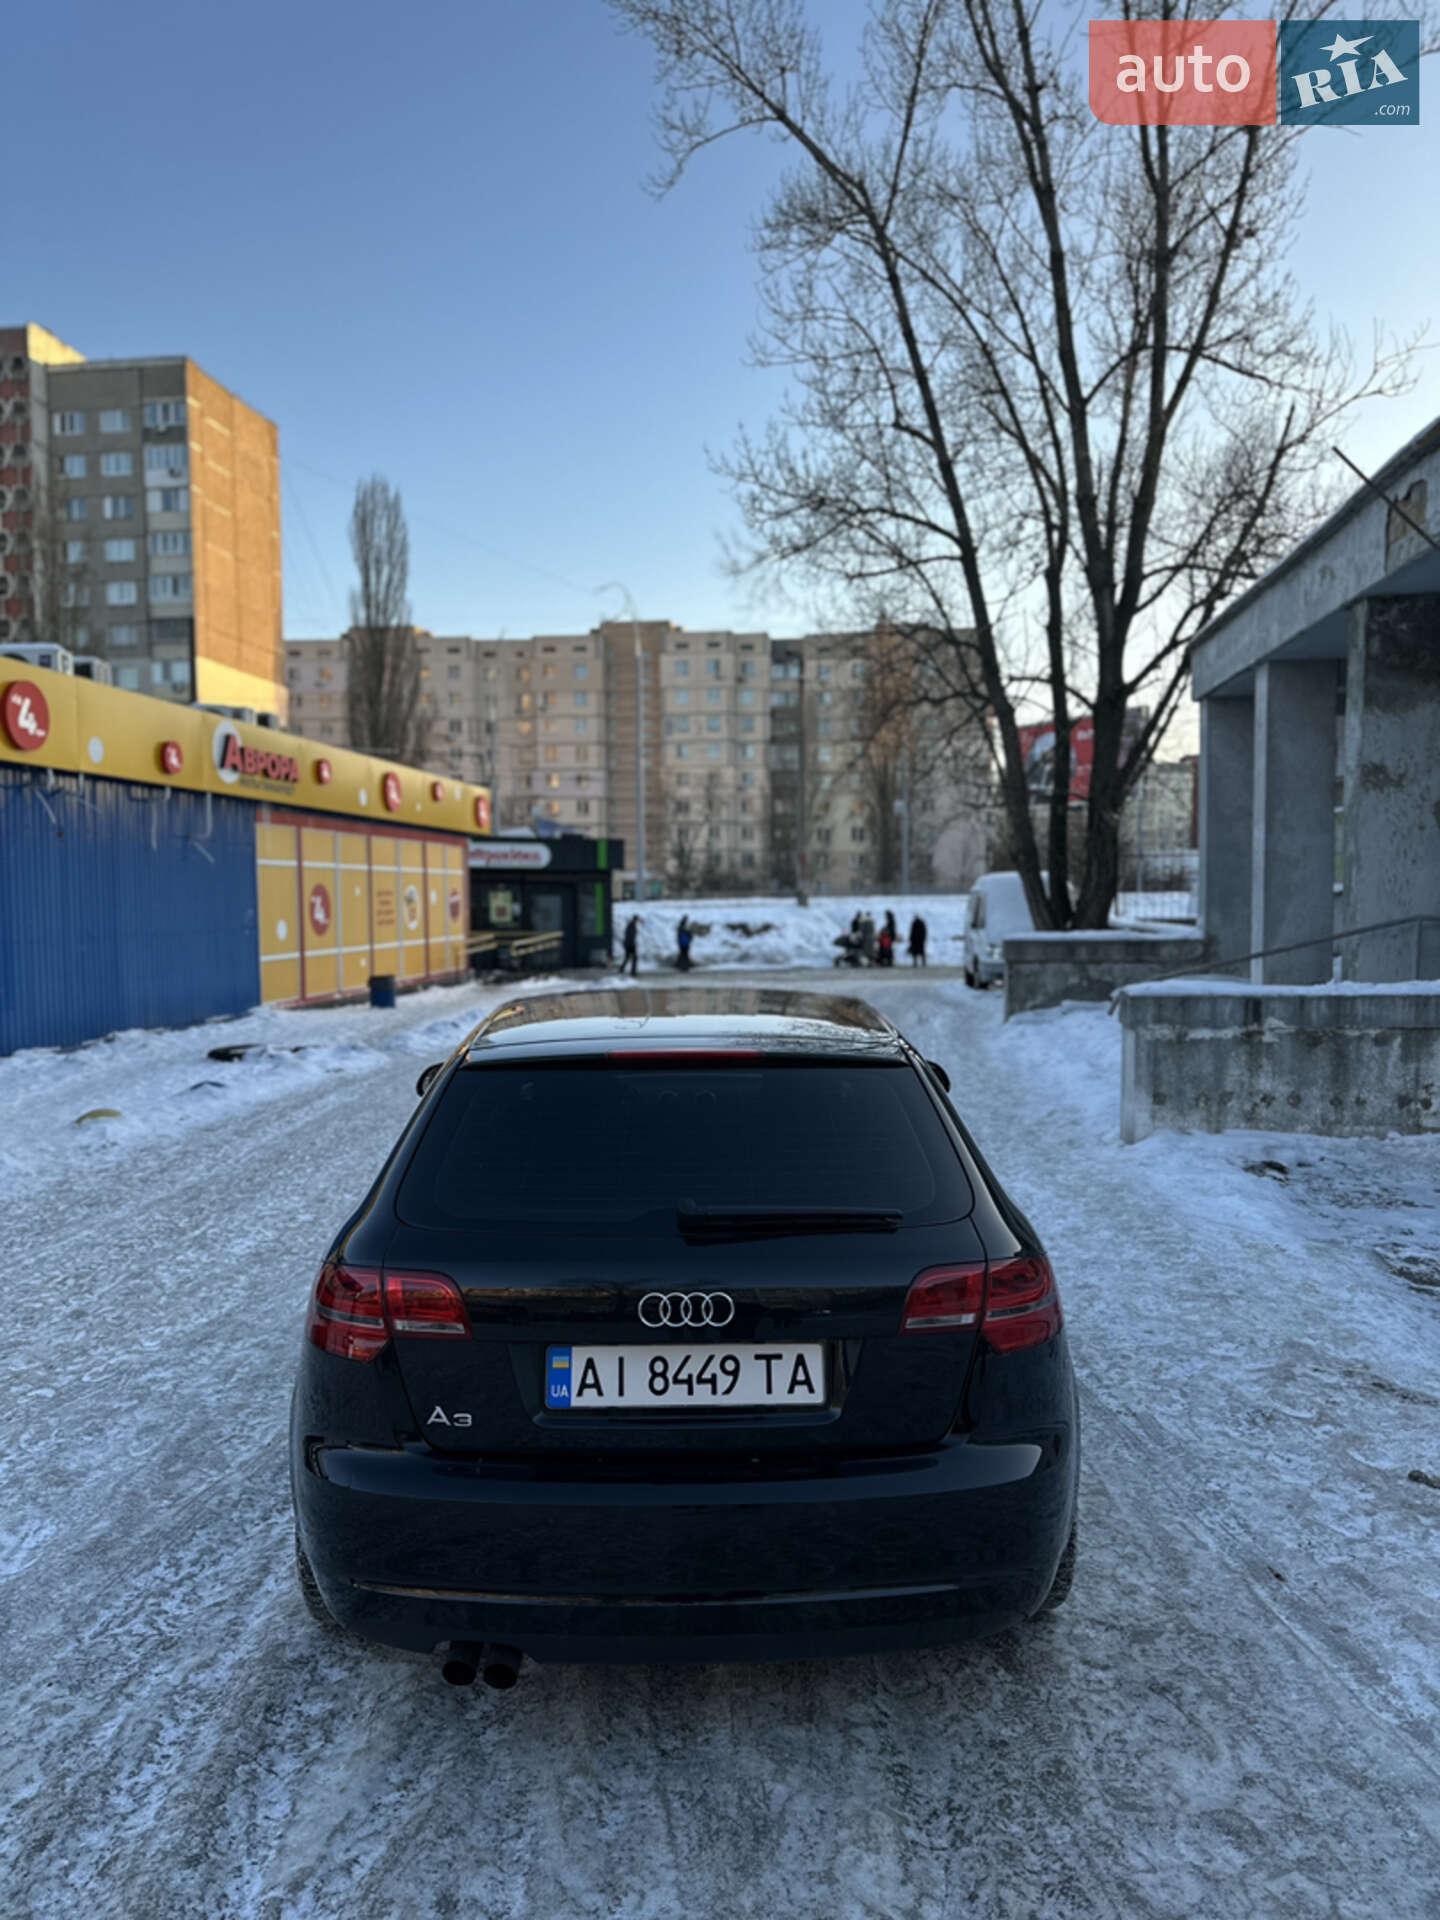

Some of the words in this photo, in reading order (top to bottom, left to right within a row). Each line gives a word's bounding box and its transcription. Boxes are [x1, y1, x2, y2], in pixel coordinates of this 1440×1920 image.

[576, 1357, 625, 1398] AI
[648, 1355, 741, 1396] 8449
[754, 1353, 815, 1395] TA
[551, 1384, 569, 1399] UA
[427, 1406, 473, 1427] A3
